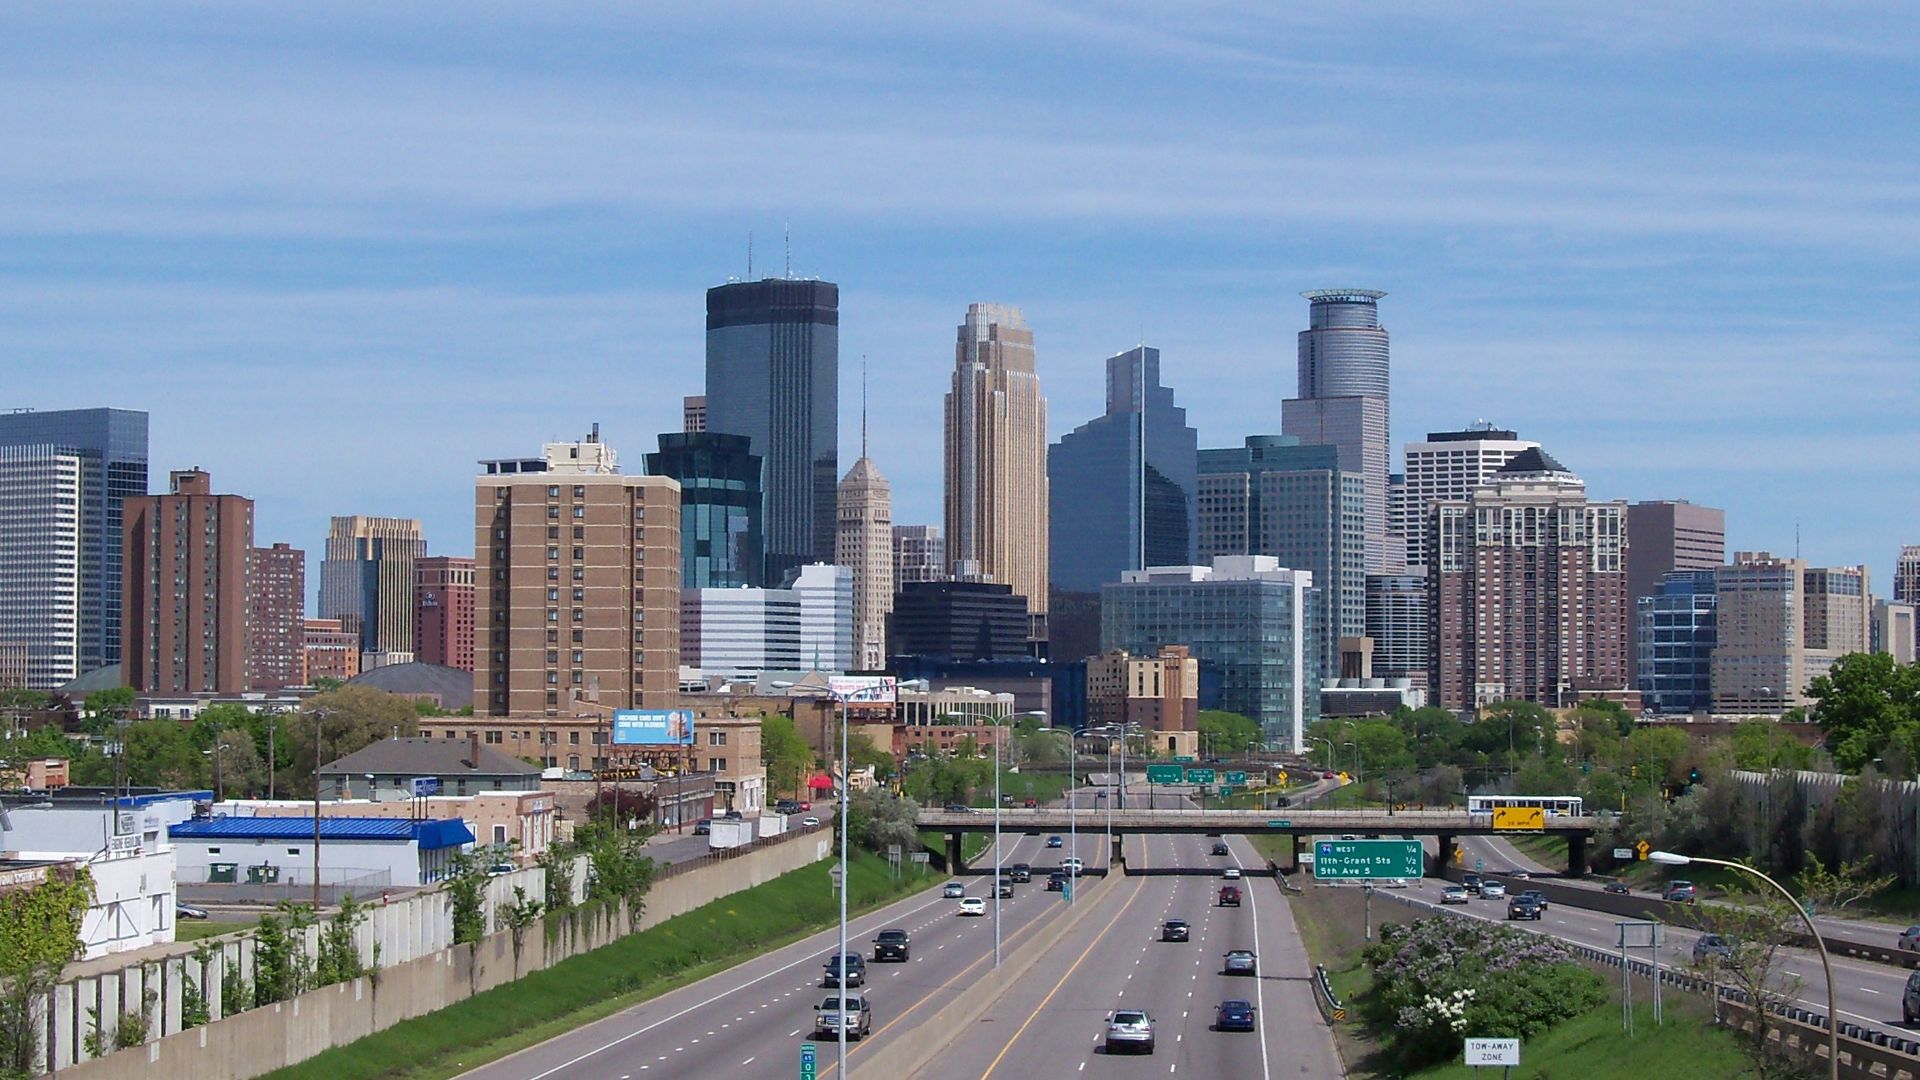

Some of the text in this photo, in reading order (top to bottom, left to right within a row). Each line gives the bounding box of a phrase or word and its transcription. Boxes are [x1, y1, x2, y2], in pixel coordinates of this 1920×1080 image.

[1320, 856, 1371, 865] 11th-Grant
[1375, 856, 1392, 865] Sts
[1320, 867, 1337, 875] 5th
[1342, 867, 1360, 875] Ave
[1364, 867, 1371, 875] S
[1482, 1053, 1503, 1061] ZONE
